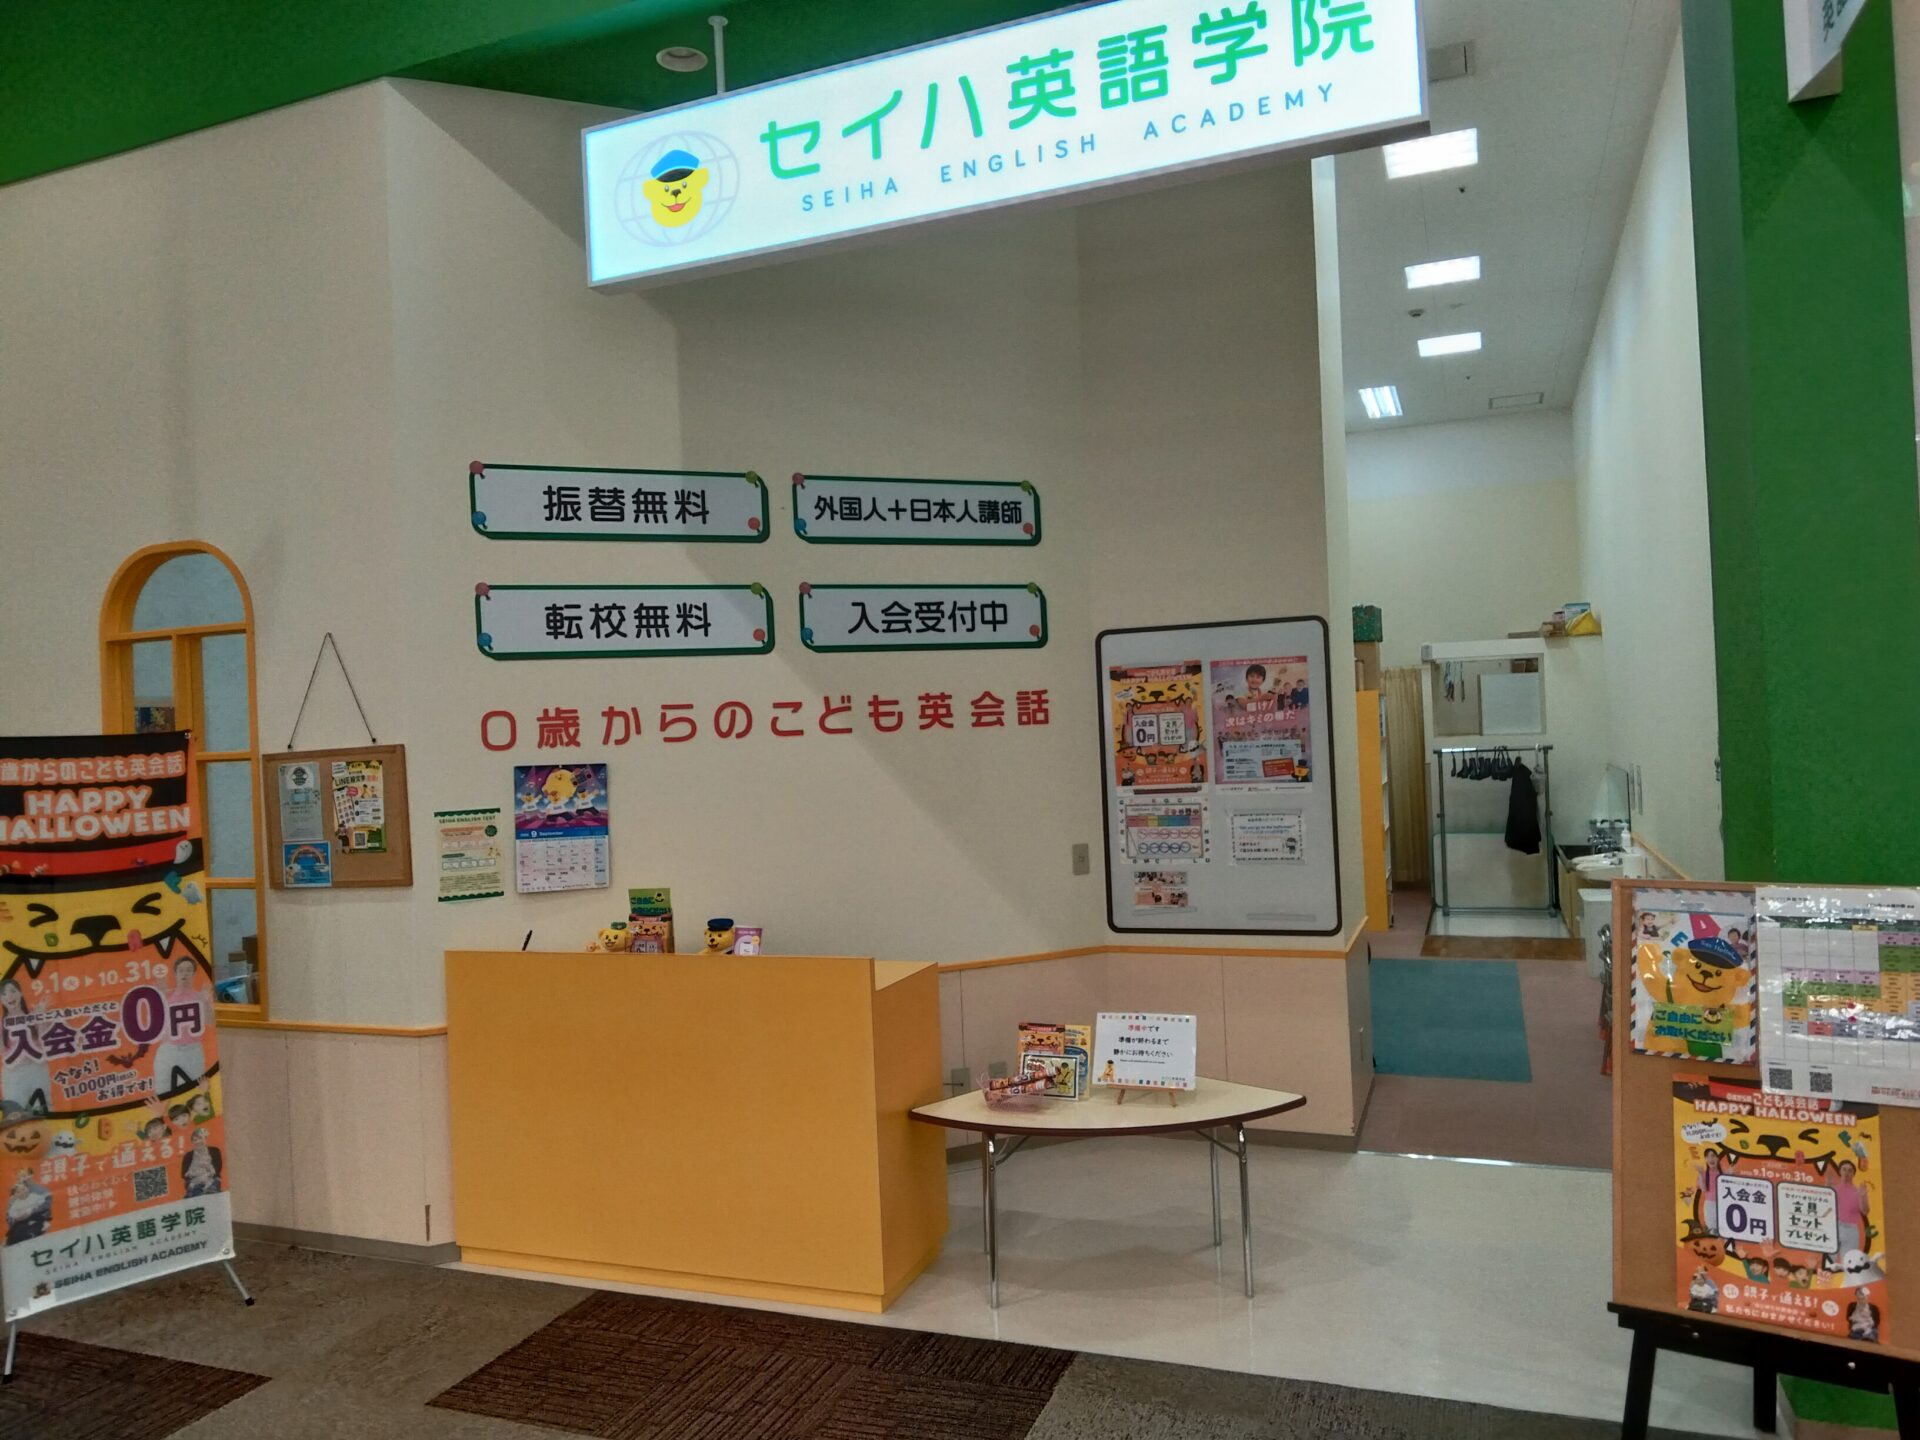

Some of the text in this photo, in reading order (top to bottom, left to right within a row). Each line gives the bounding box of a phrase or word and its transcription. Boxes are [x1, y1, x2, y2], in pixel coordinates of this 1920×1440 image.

[759, 0, 1375, 181] セイハ英語学院
[800, 83, 1336, 213] SEIHA ENGLISH ACADEMY
[543, 486, 710, 525] 振替無料
[544, 602, 712, 639] 転校無料
[847, 600, 1008, 635] 入会受付中
[1136, 728, 1155, 743] 0円
[27, 788, 149, 816] HAPPY
[1694, 1099, 1857, 1127] HAPPY HALLOWEEN
[1722, 1186, 1767, 1205] 入会金
[1726, 1203, 1767, 1236] 0円
[1787, 1230, 1830, 1242] プレゼント
[1789, 1214, 1823, 1228] セット
[30, 1207, 206, 1267] セイハ英語学院
[54, 1240, 207, 1289] SEIHA ENGLISH ACADEMY
